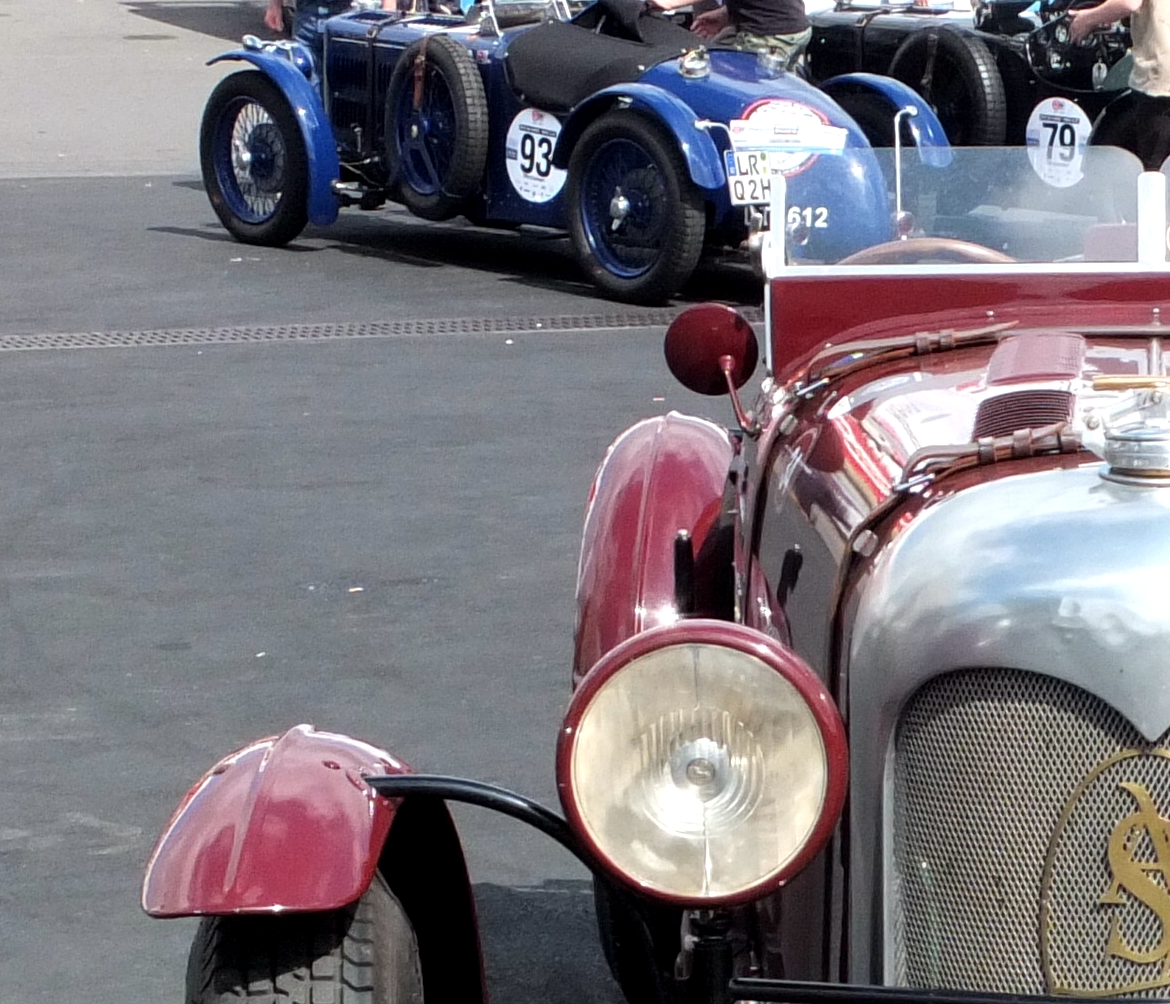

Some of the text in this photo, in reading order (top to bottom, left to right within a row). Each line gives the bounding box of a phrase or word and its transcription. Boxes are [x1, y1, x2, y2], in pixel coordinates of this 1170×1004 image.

[520, 133, 552, 178] 93
[1042, 122, 1076, 162] 79
[736, 154, 760, 176] LR
[787, 206, 829, 228] 612
